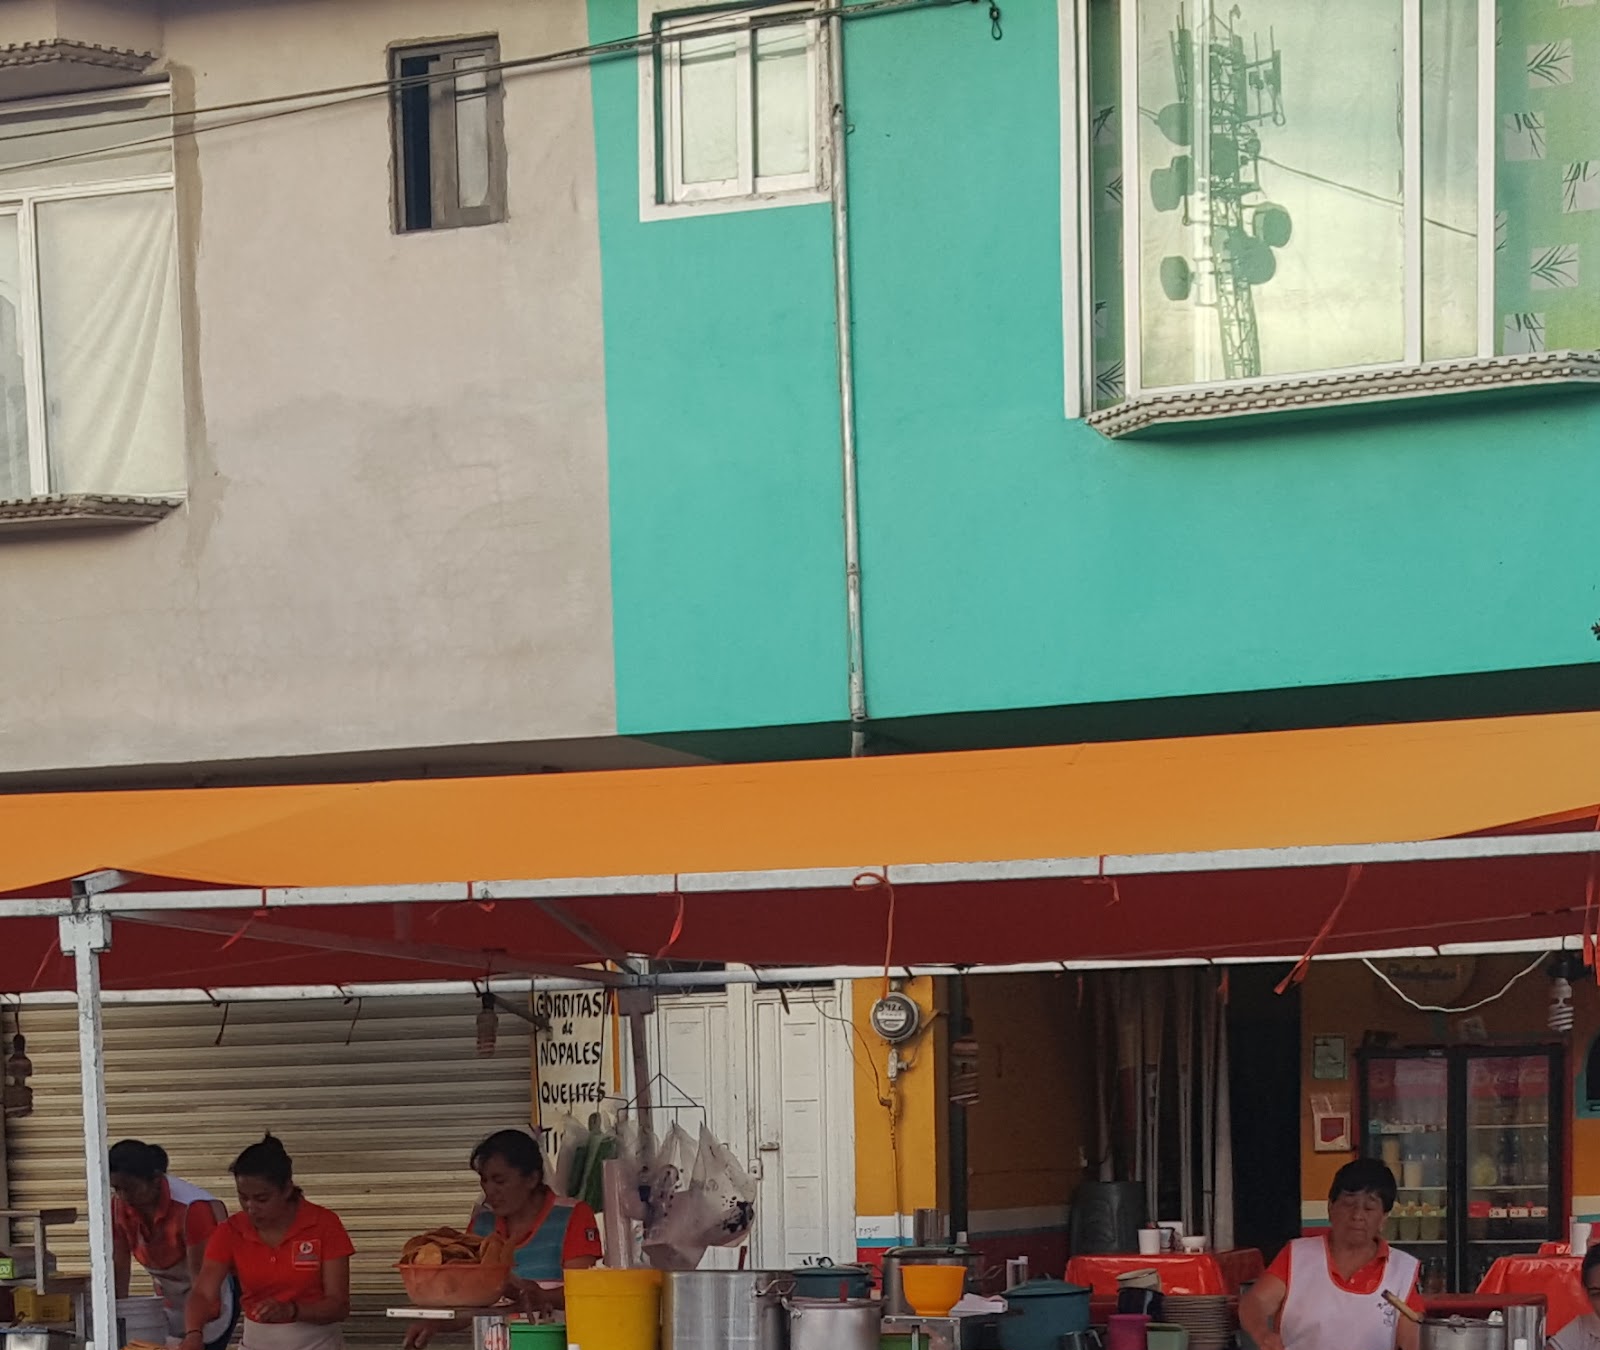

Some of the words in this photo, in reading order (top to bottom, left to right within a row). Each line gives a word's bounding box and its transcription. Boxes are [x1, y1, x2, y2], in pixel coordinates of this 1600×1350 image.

[536, 992, 600, 1019] GORDITAS
[561, 1020, 574, 1035] de
[540, 1042, 601, 1067] NOPALES
[541, 1081, 606, 1104] QUELITES
